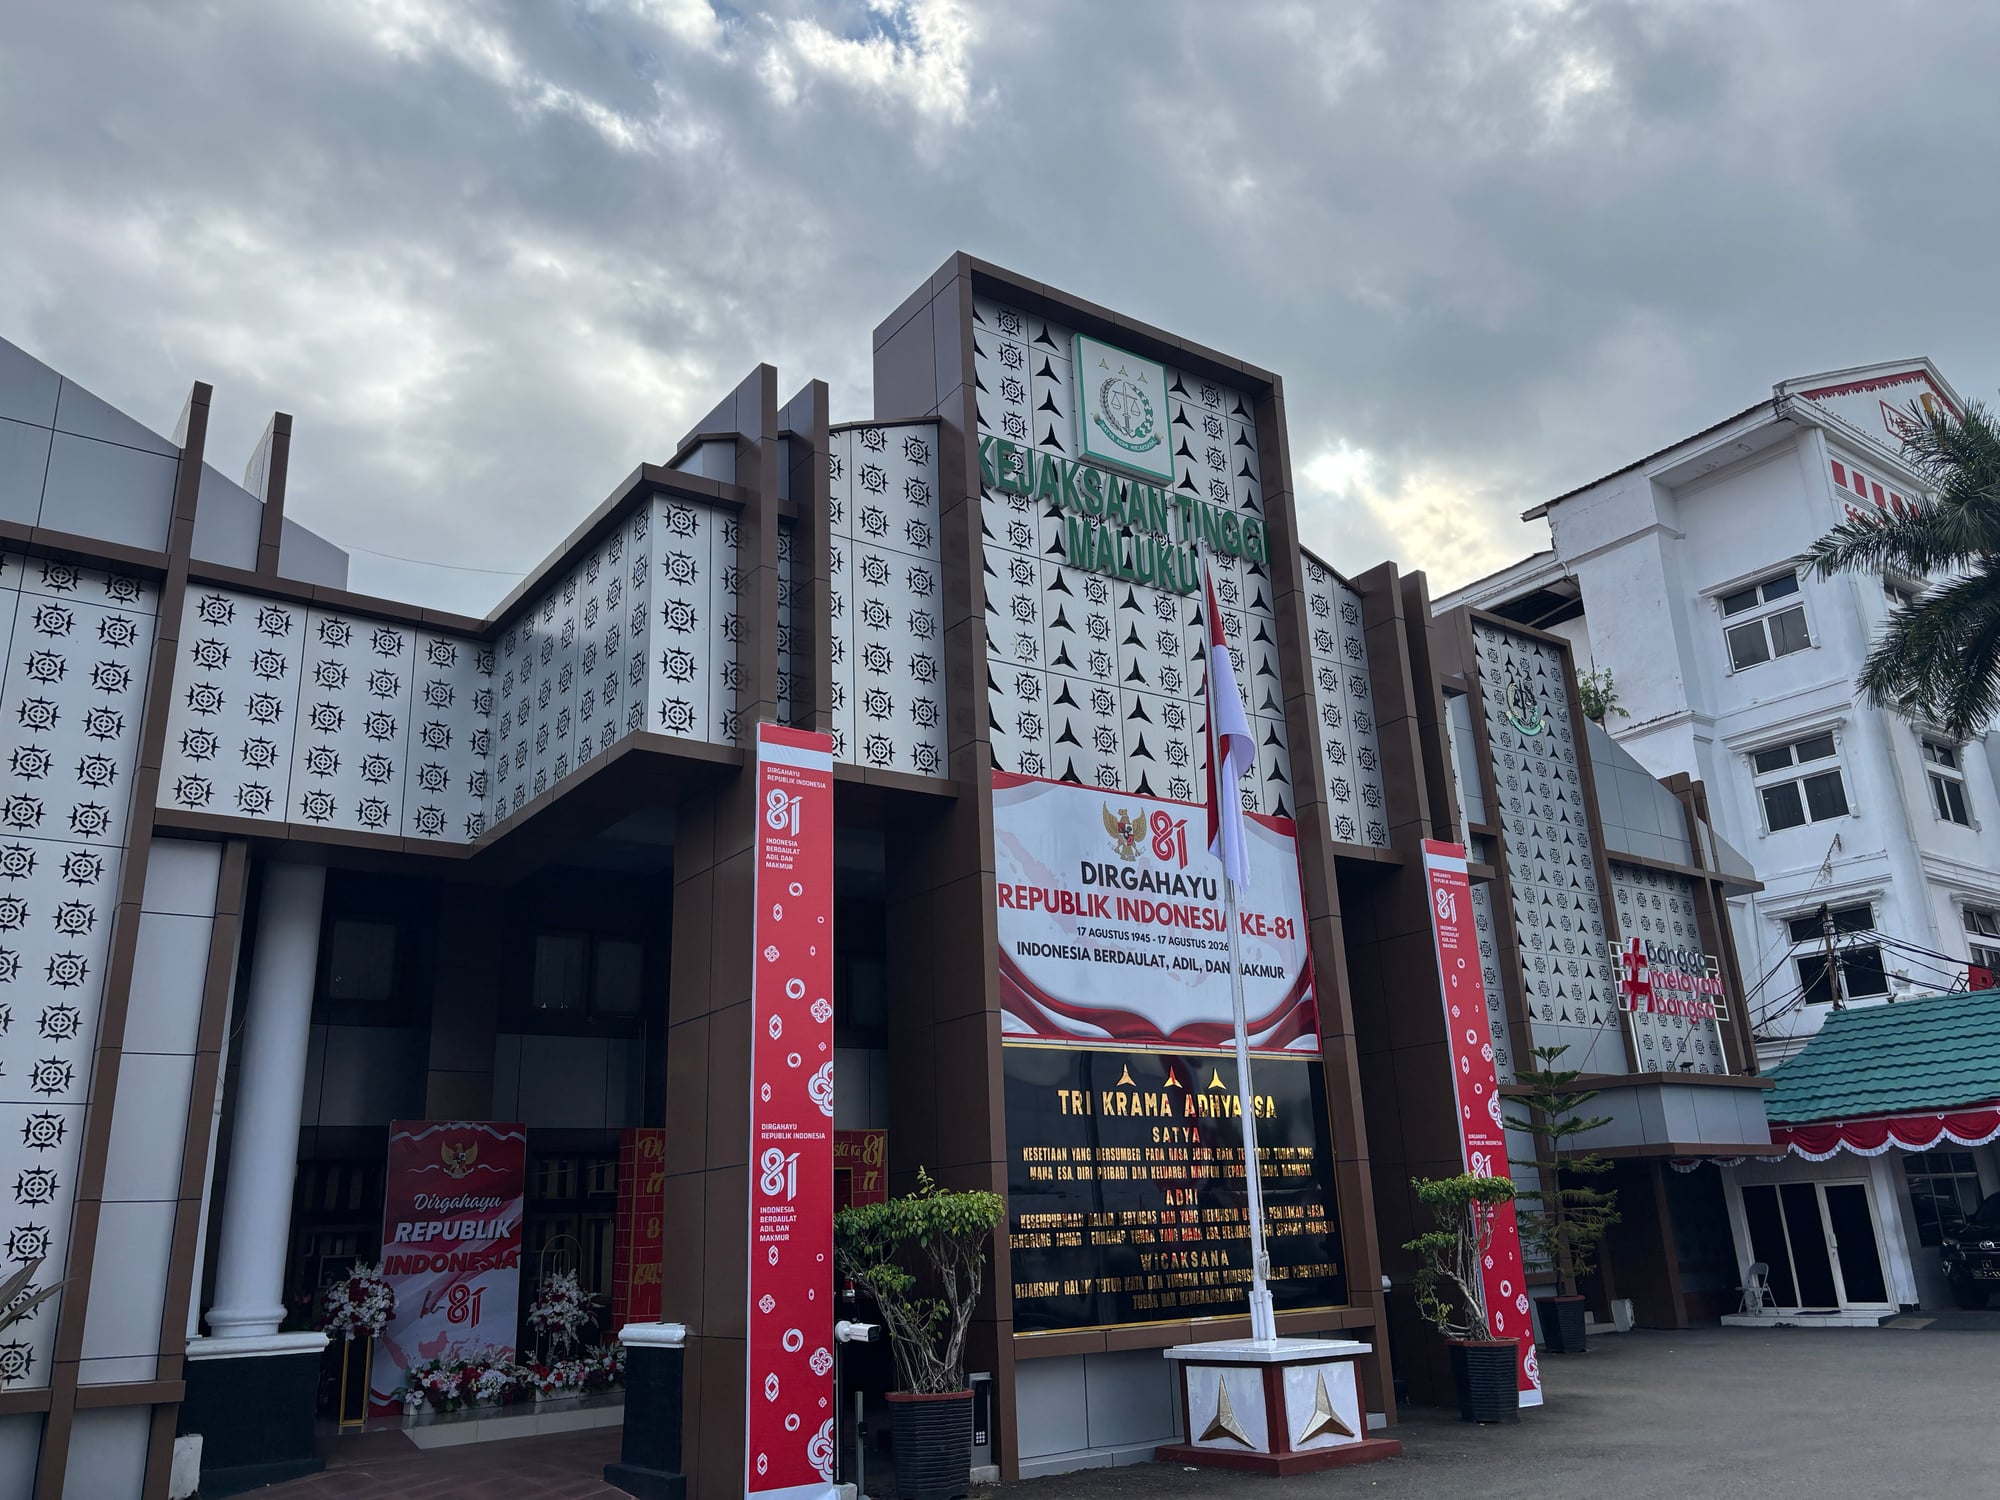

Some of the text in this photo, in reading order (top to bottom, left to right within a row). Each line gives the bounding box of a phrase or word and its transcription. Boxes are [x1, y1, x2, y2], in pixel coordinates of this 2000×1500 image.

[979, 436, 1271, 566] KEJAKSAAN TINGGI
[1065, 516, 1197, 595] MALUKU
[767, 766, 800, 777] DIRGAHAYU
[767, 774, 826, 789] REPUBLIK INDONESIA
[766, 788, 803, 837] 81
[766, 838, 798, 847] INDONESIA
[1150, 810, 1188, 870] 81
[766, 845, 800, 855] BERDAULAT
[766, 853, 793, 862] ADIL DAN
[766, 861, 793, 870] MAKMUR
[1081, 861, 1217, 901] DIRGAHAYU
[998, 883, 1295, 940] REPUBLIK INDONESIA KE-81
[1435, 887, 1458, 924] 81
[1077, 926, 1086, 937] 17
[1088, 928, 1130, 942] AGUSTUS
[1131, 931, 1151, 943] 1945
[1158, 934, 1167, 944] 17
[1168, 936, 1206, 949] AGUSTUS
[1208, 941, 1229, 951] 2026
[1017, 942, 1090, 962] INDONESIA
[1094, 949, 1170, 971] BERDAULAT,
[1173, 957, 1203, 973] ADIL,
[1206, 959, 1230, 973] DAN
[1652, 991, 1715, 1024] bangsa
[1058, 1090, 1278, 1119] TRI KRAMA ADHYASA
[761, 1123, 798, 1131] DIRGAHAYU
[1152, 1126, 1201, 1143] SATYA
[761, 1132, 826, 1140] REPUBLIK INDONESIA
[1023, 1147, 1067, 1161] KESETIAAN
[1072, 1147, 1091, 1161] YANG
[1096, 1148, 1141, 1161] BERSUMBER
[1145, 1148, 1165, 1161] PADA
[760, 1147, 801, 1202] 81
[1077, 1166, 1093, 1180] DIRI
[1097, 1166, 1129, 1180] PRIBADI
[1132, 1166, 1148, 1180] DAN
[1151, 1166, 1187, 1179] KELUARGA
[413, 1193, 503, 1215] Dirgahayu
[1166, 1188, 1199, 1206] ADHI
[760, 1206, 795, 1214] INDONESIA
[1180, 1209, 1199, 1224] YANG
[760, 1215, 797, 1223] BERDAULAT
[394, 1217, 514, 1243] REPUBLIK
[760, 1224, 790, 1233] ADIL DAN
[760, 1234, 790, 1242] MAKMUR
[383, 1250, 519, 1276] INDONESIA
